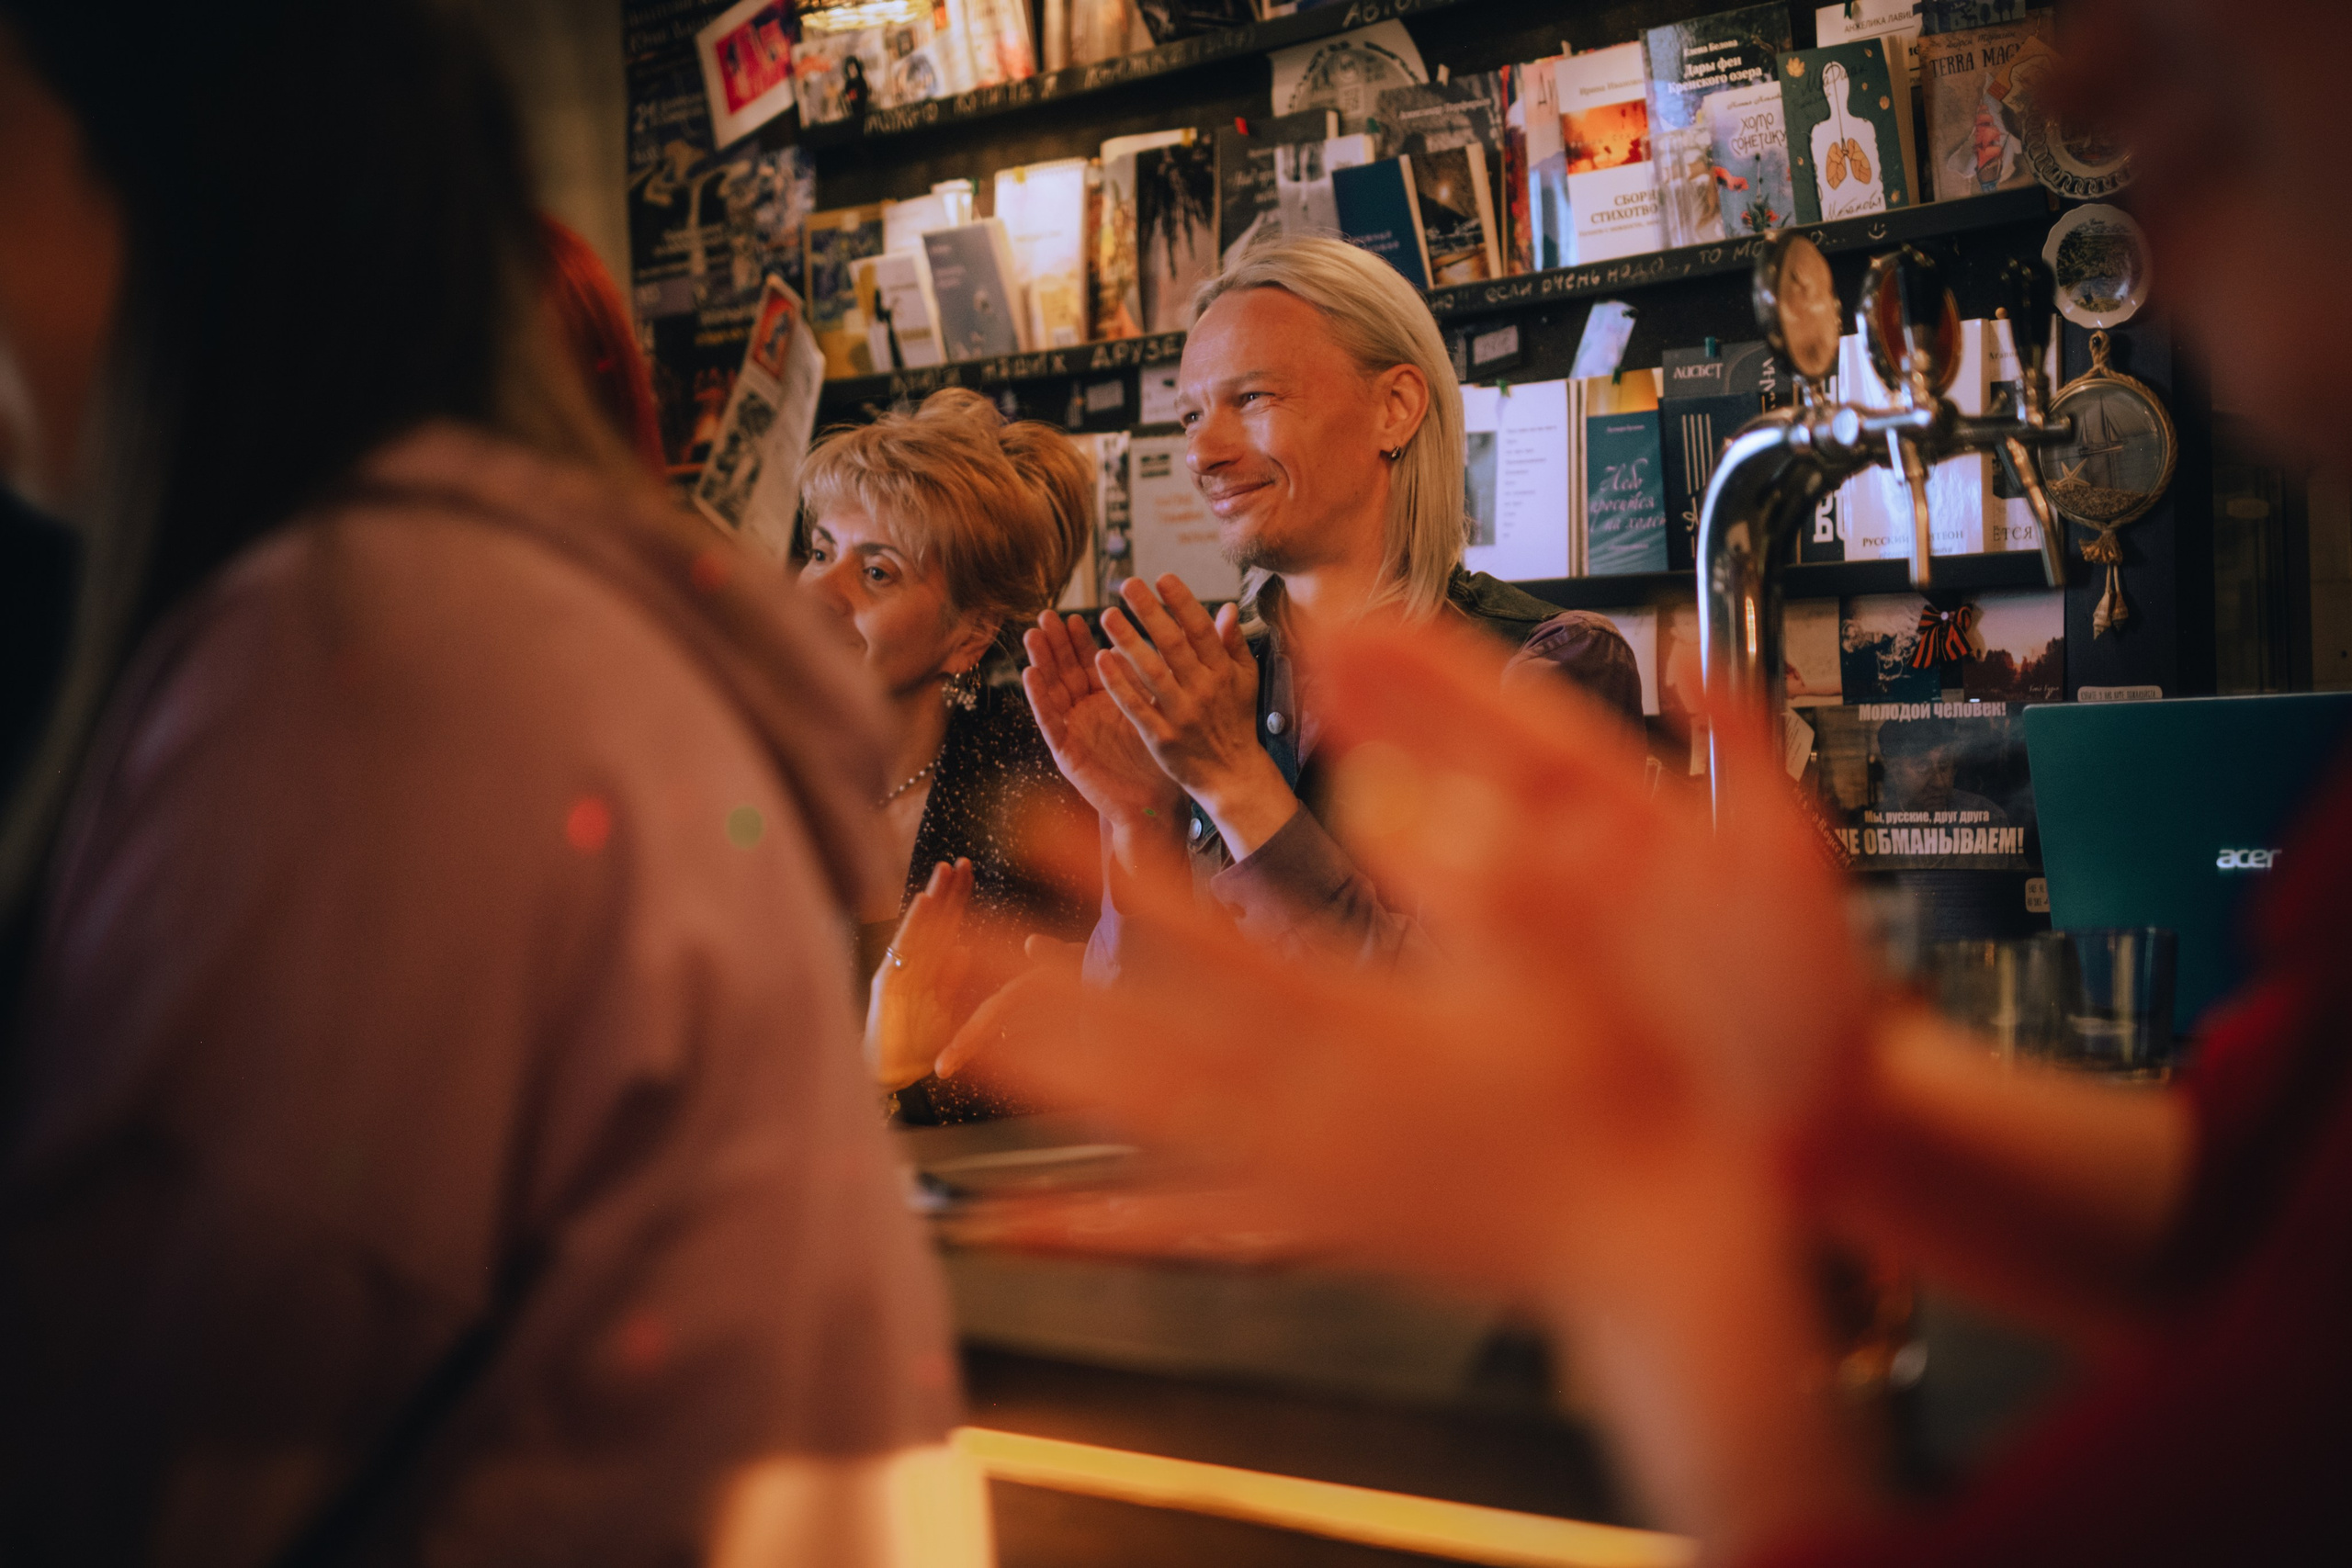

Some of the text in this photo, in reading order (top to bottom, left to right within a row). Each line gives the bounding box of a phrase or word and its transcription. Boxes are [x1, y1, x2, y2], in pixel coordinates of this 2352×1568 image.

[1844, 16, 1886, 33] АНЖЕЛИКА
[1683, 55, 1742, 80] Дары феи
[1728, 65, 1763, 81] озера
[1929, 51, 1974, 78] TERRA
[1864, 810, 1990, 825] Мы, русские, друг друга
[1863, 827, 2025, 855] ОБМАНЫВАЕМ!
[2215, 848, 2282, 868] acer
